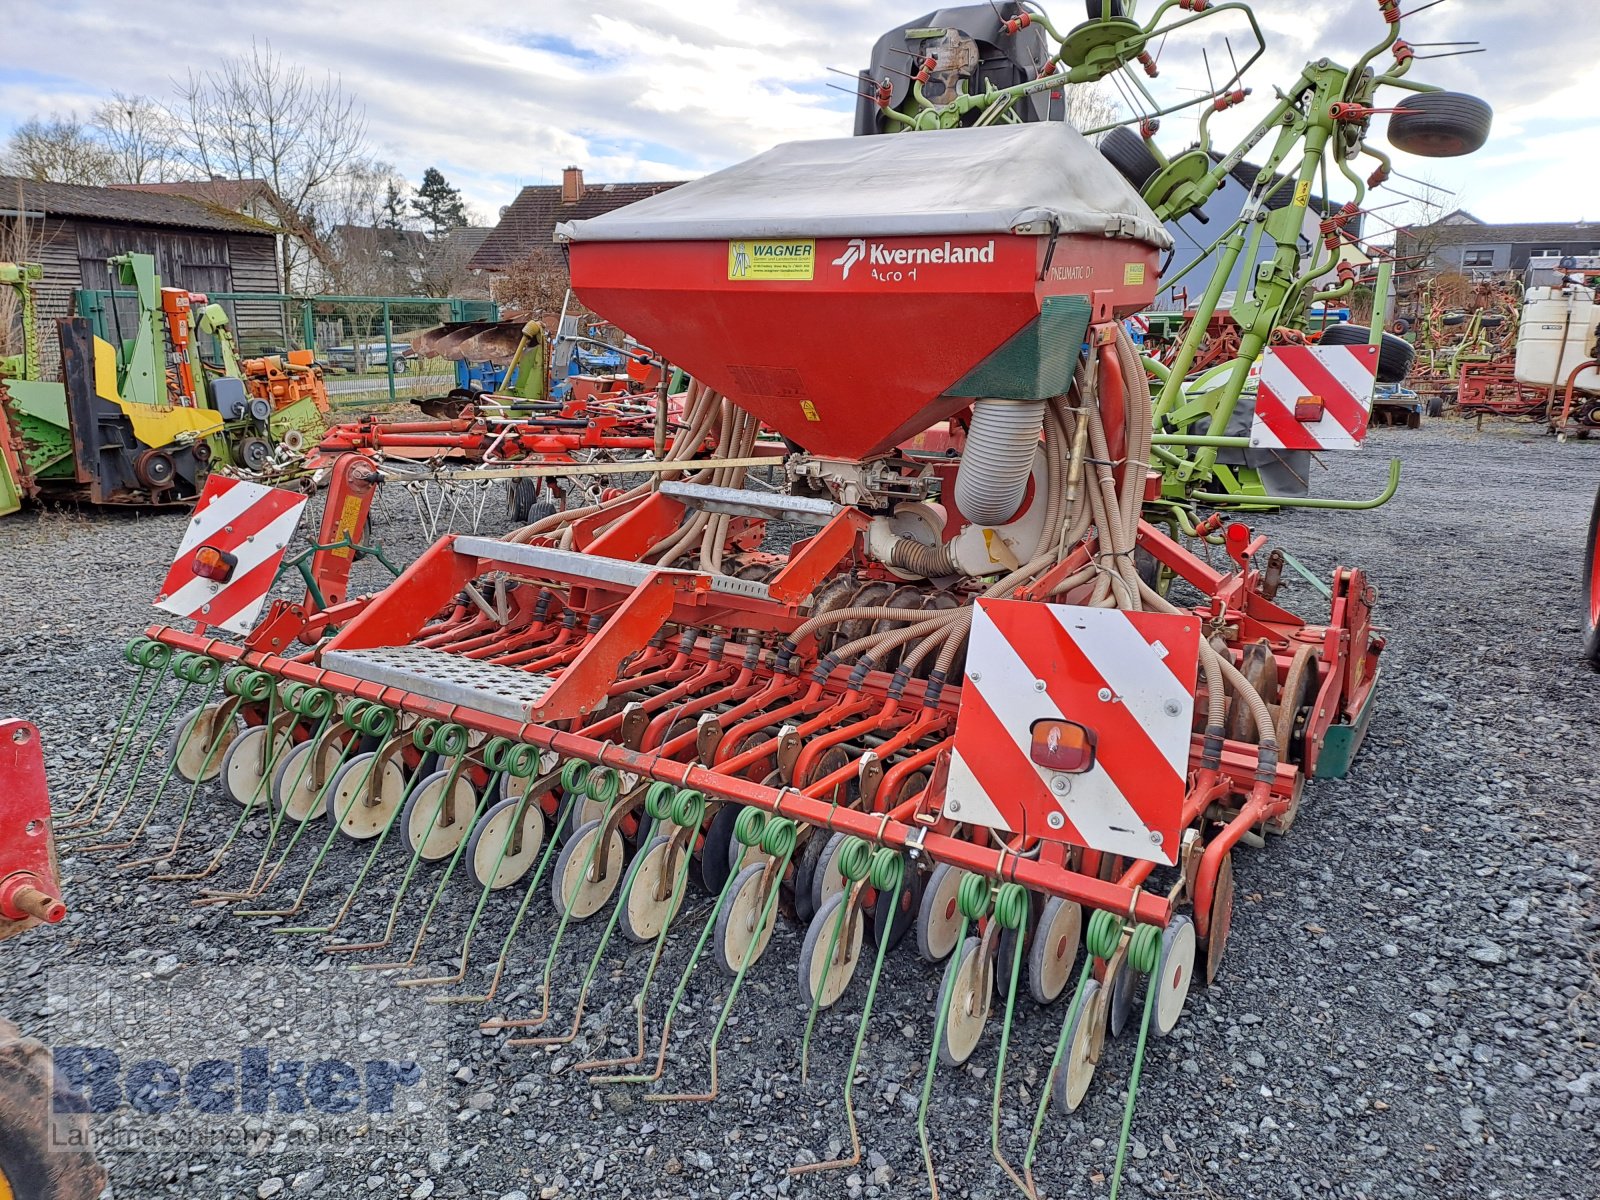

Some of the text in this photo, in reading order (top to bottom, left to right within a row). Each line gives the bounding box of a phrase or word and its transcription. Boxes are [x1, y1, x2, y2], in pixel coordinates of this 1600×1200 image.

[753, 245, 812, 256] WAGNER
[870, 240, 995, 265] Kverneland
[1050, 266, 1083, 280] PNEUMATIC
